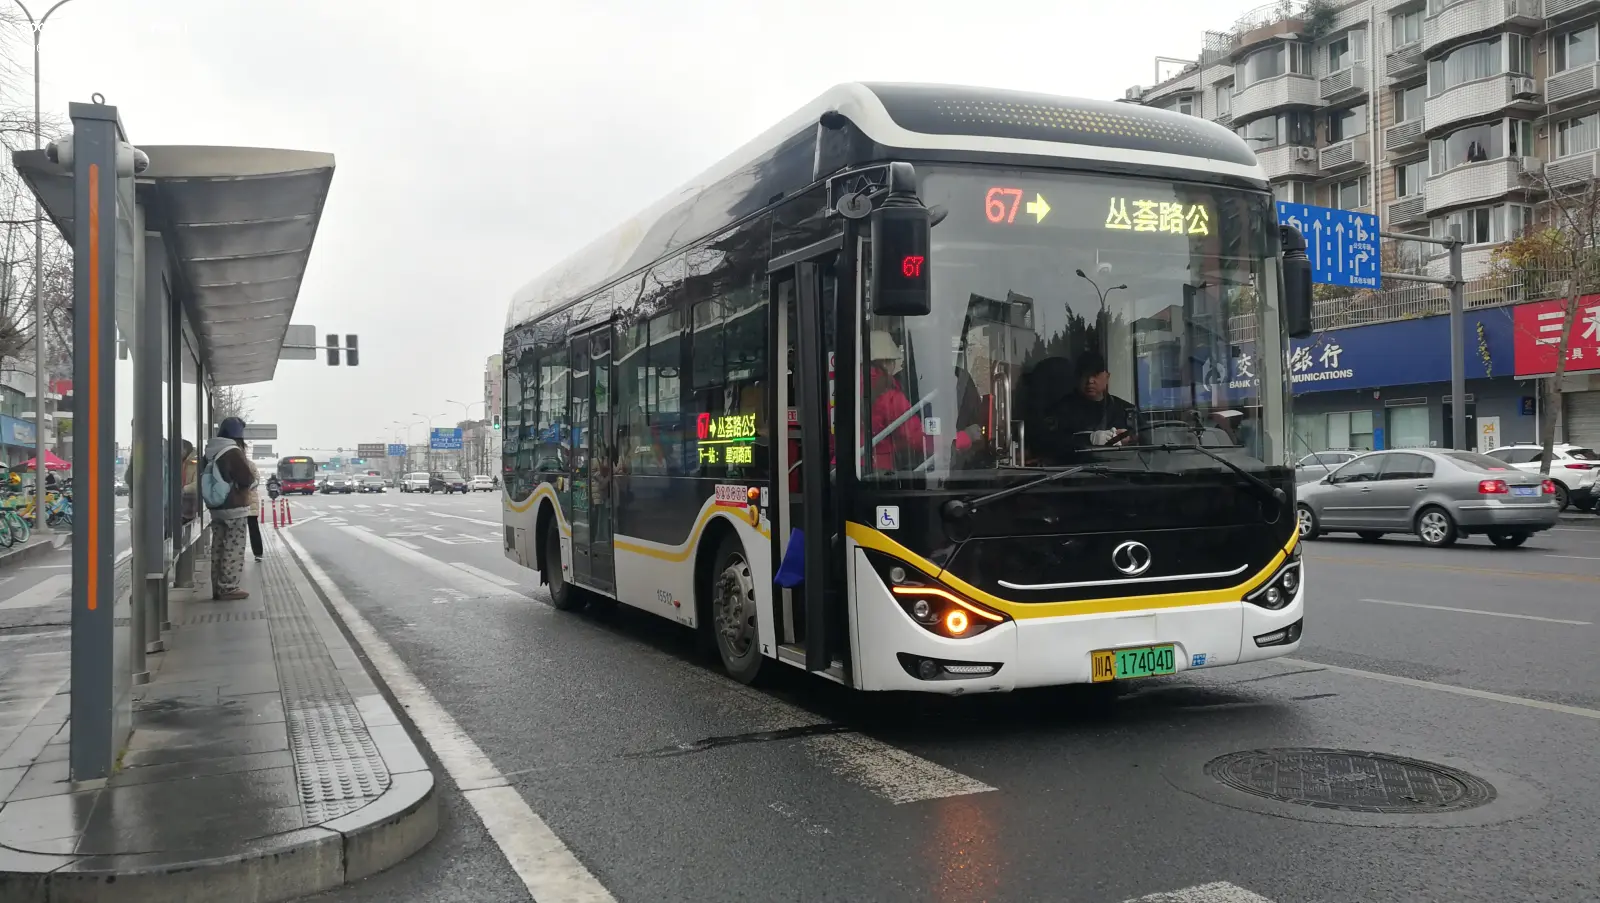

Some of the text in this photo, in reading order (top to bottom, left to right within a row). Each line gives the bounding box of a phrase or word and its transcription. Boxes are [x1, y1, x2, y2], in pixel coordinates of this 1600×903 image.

[985, 187, 1024, 224] 67
[1105, 197, 1209, 236] 丛荟路公
[903, 256, 924, 277] 67
[1291, 369, 1354, 383] MUNICATIONS
[697, 412, 710, 439] 67
[1094, 655, 1113, 678] 川A
[1121, 649, 1174, 675] 17404D
